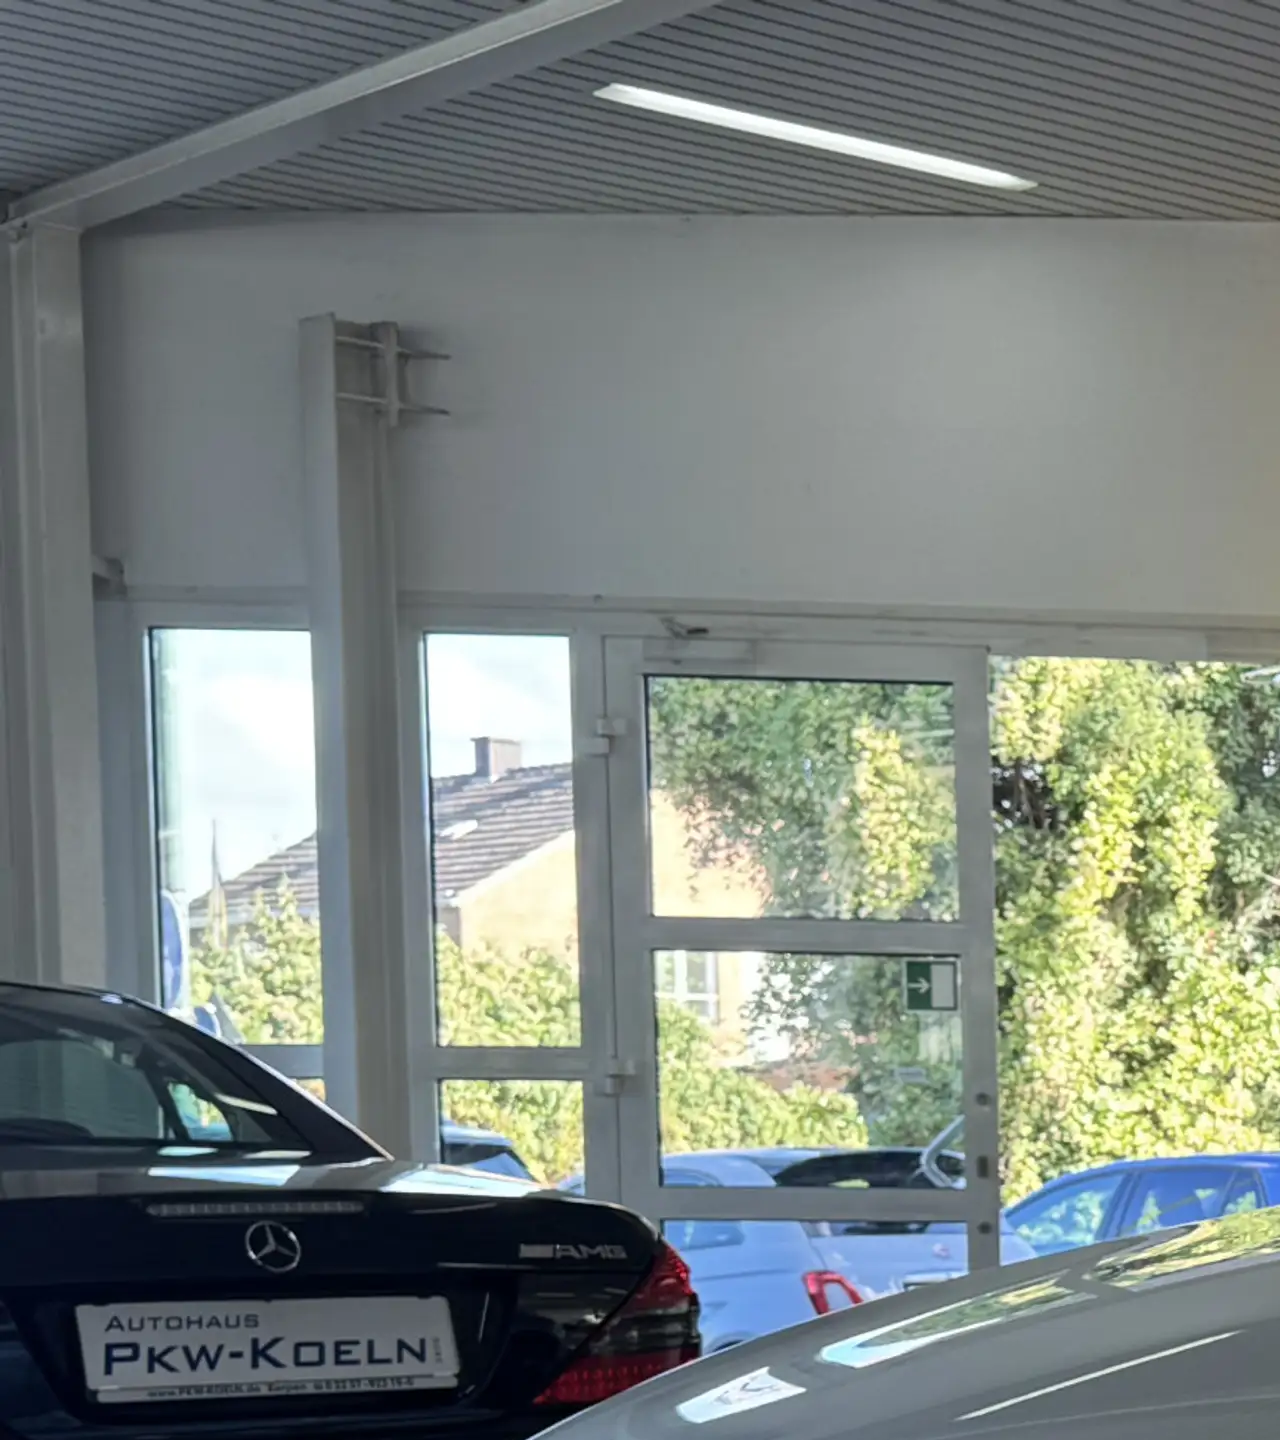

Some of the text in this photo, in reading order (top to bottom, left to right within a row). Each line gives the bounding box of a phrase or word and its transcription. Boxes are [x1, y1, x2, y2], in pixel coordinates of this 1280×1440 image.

[555, 1244, 628, 1260] AMG
[104, 1314, 260, 1333] AUTOHAUS
[103, 1337, 426, 1376] PKW-KOELN
